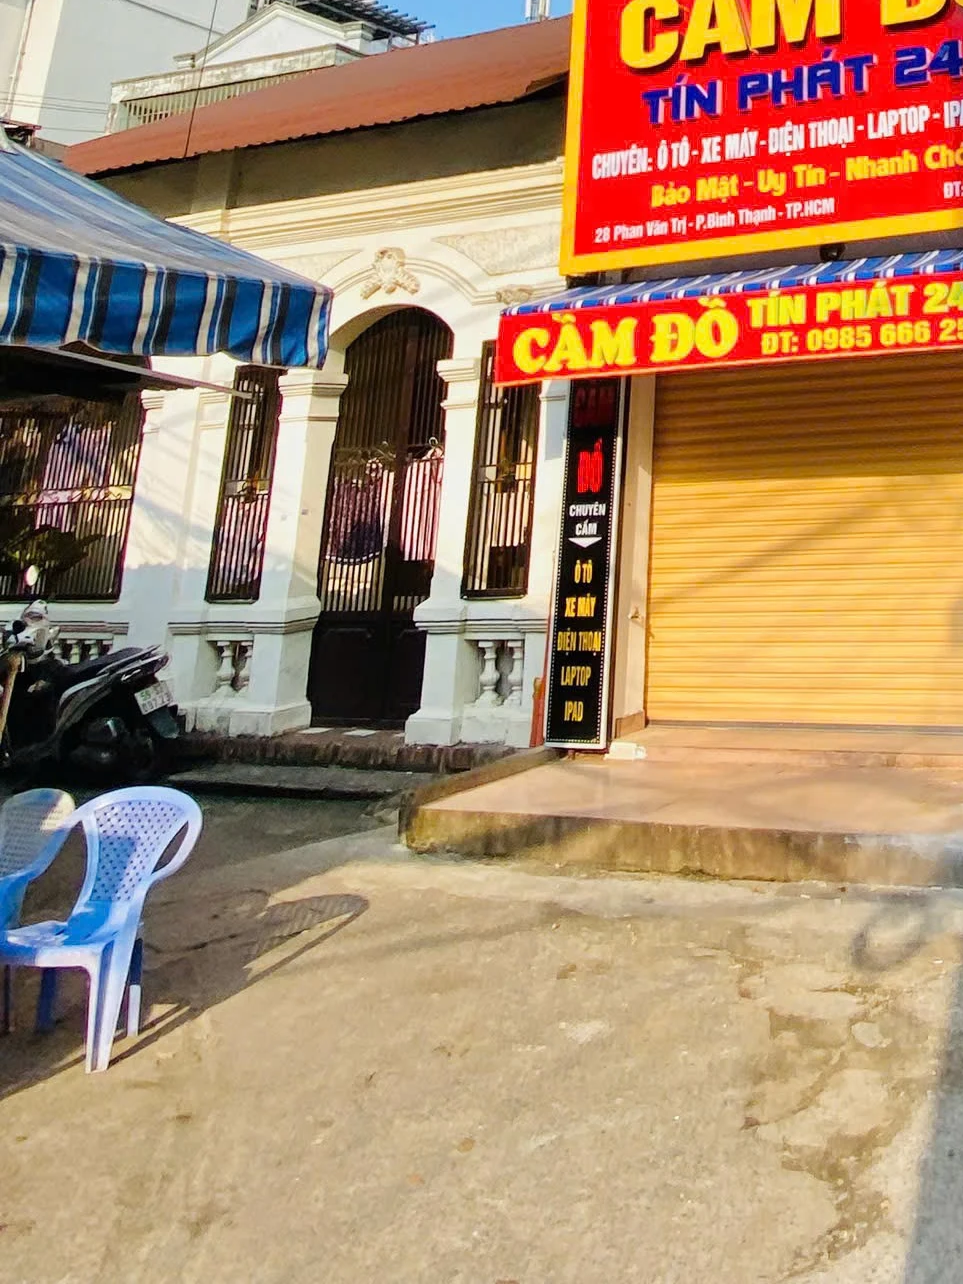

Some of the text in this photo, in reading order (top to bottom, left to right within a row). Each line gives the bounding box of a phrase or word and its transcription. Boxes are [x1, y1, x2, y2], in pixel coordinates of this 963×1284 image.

[641, 73, 721, 124] TÍN
[737, 48, 876, 112] PHÁT
[592, 144, 653, 179] CHUYÊN:
[657, 140, 669, 171] Ô
[671, 136, 690, 168] TÔ
[701, 137, 721, 164] XE
[725, 127, 759, 160] MÁY
[768, 121, 804, 156] ĐIỆN
[808, 116, 855, 148] THOẠI
[867, 105, 931, 139] LAPTOP
[651, 182, 691, 207] Bảo
[696, 174, 740, 203] Mật
[757, 168, 787, 197] Uy
[793, 163, 826, 188] Tín
[845, 149, 918, 181] Nhanh
[594, 227, 611, 244] 28
[613, 224, 643, 240] Phan
[646, 220, 669, 236] Văn
[671, 217, 687, 235] Trị
[738, 206, 776, 226] Thạnh
[786, 197, 835, 219] TP.HCM
[747, 291, 807, 328] TÍN
[815, 281, 915, 323] PHÁT
[512, 297, 739, 373] CẦM ĐỒ
[761, 331, 799, 355] ĐT:
[806, 325, 872, 351] 0985
[879, 320, 930, 346] 666
[569, 501, 606, 517] CHUYÊN
[574, 560, 593, 584] Ô TÔ
[565, 593, 596, 617] XE MÁY
[578, 630, 601, 656] THOẠI
[560, 666, 591, 686] LAPTOP
[564, 700, 584, 722] IPAD
